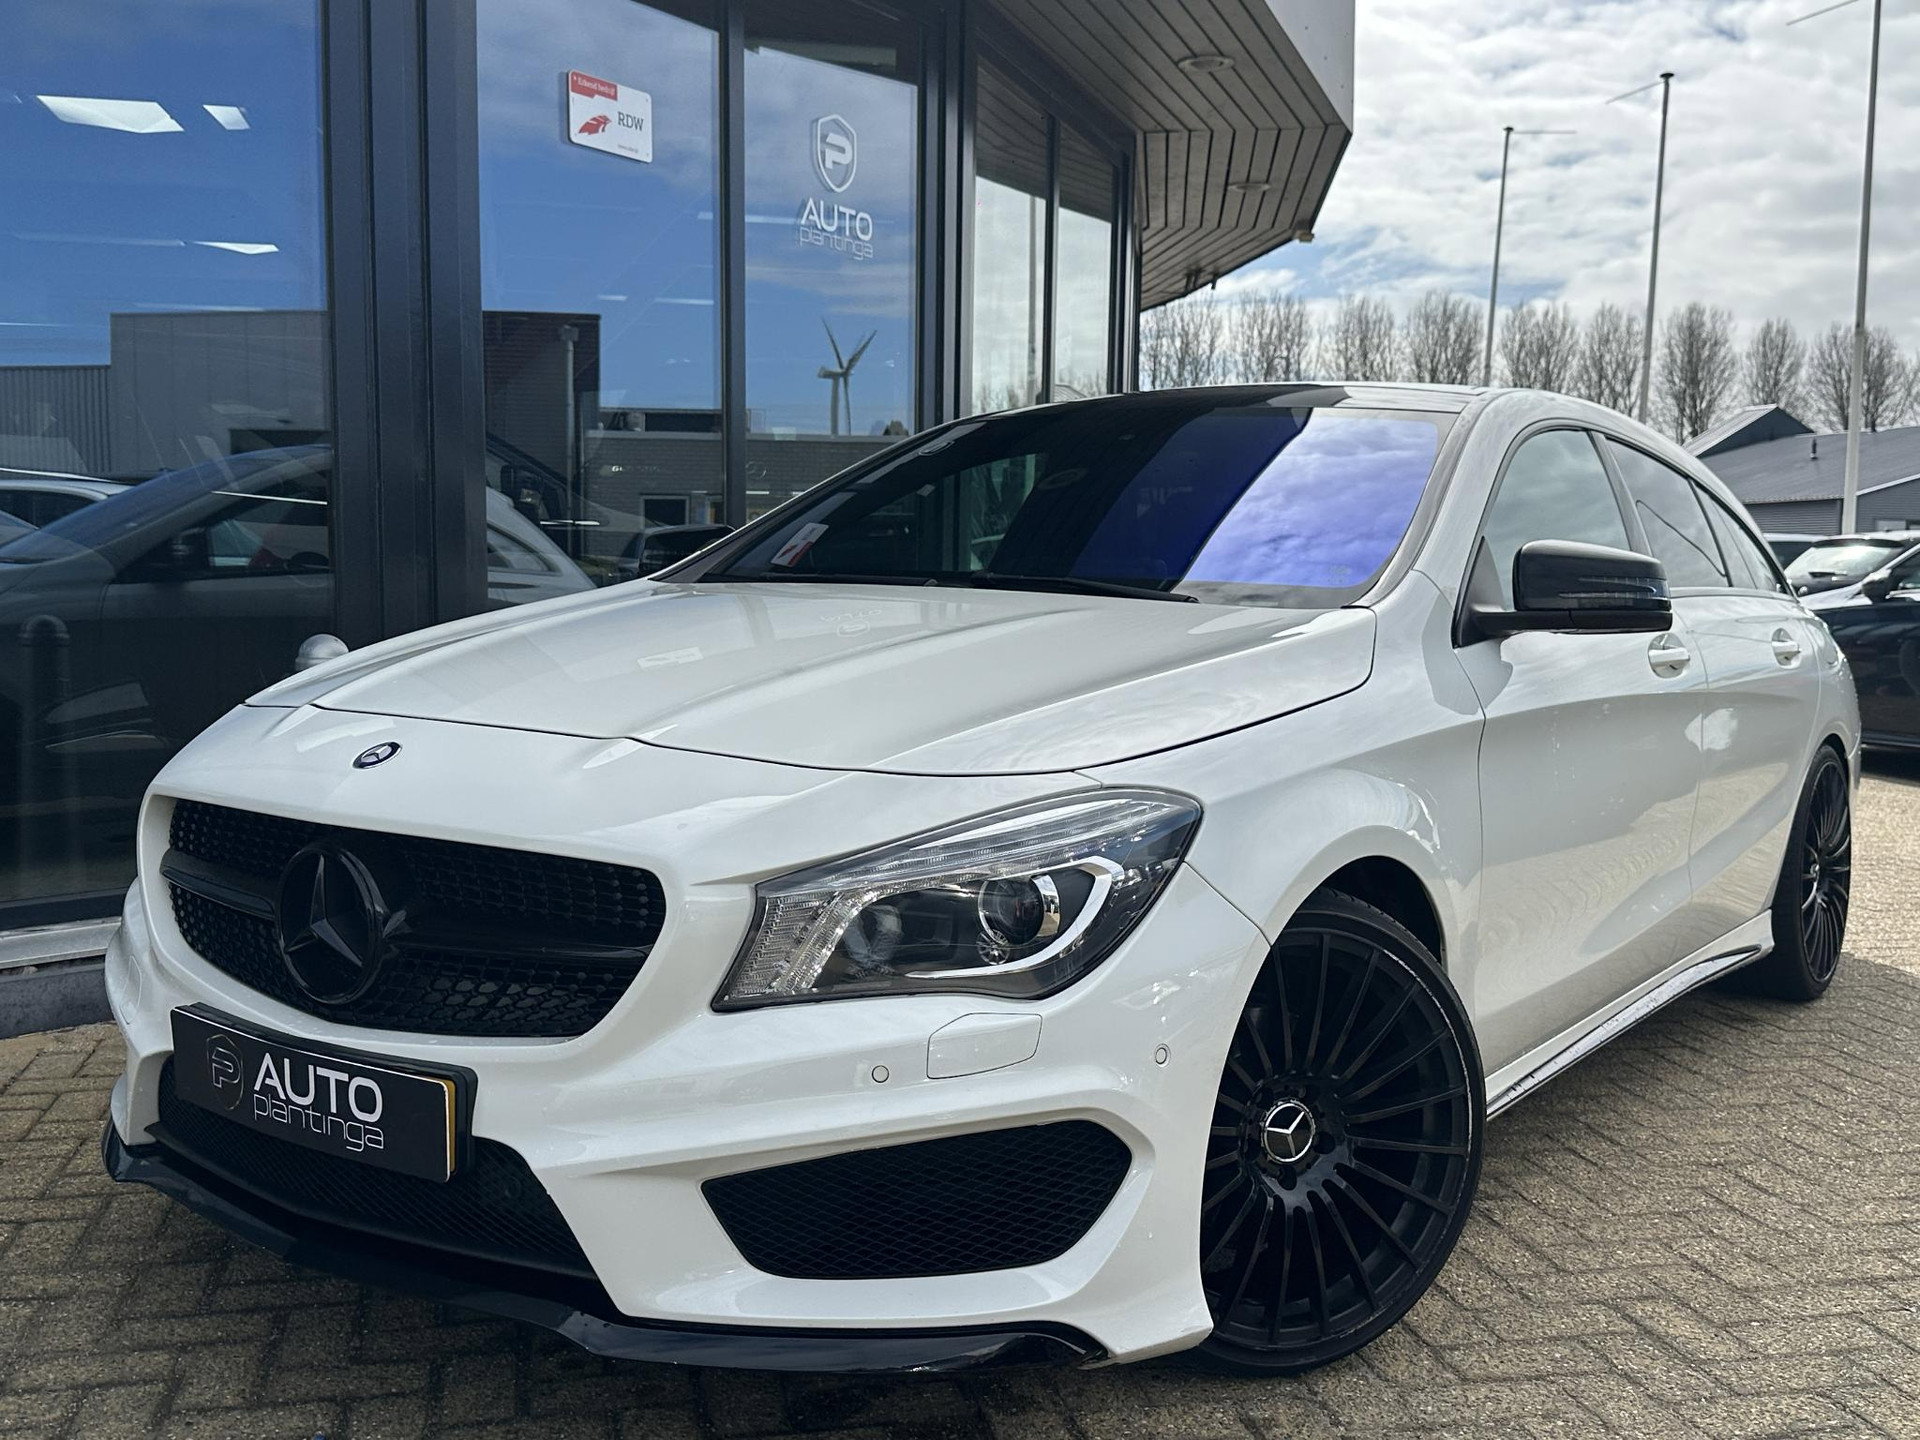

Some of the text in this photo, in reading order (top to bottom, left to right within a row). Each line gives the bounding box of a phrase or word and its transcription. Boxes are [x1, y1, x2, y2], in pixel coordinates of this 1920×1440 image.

[617, 111, 644, 132] RDW
[800, 197, 873, 241] AUTO
[800, 226, 874, 260] plantinga
[253, 1052, 383, 1123] AUTO
[253, 1093, 385, 1152] plantinga
